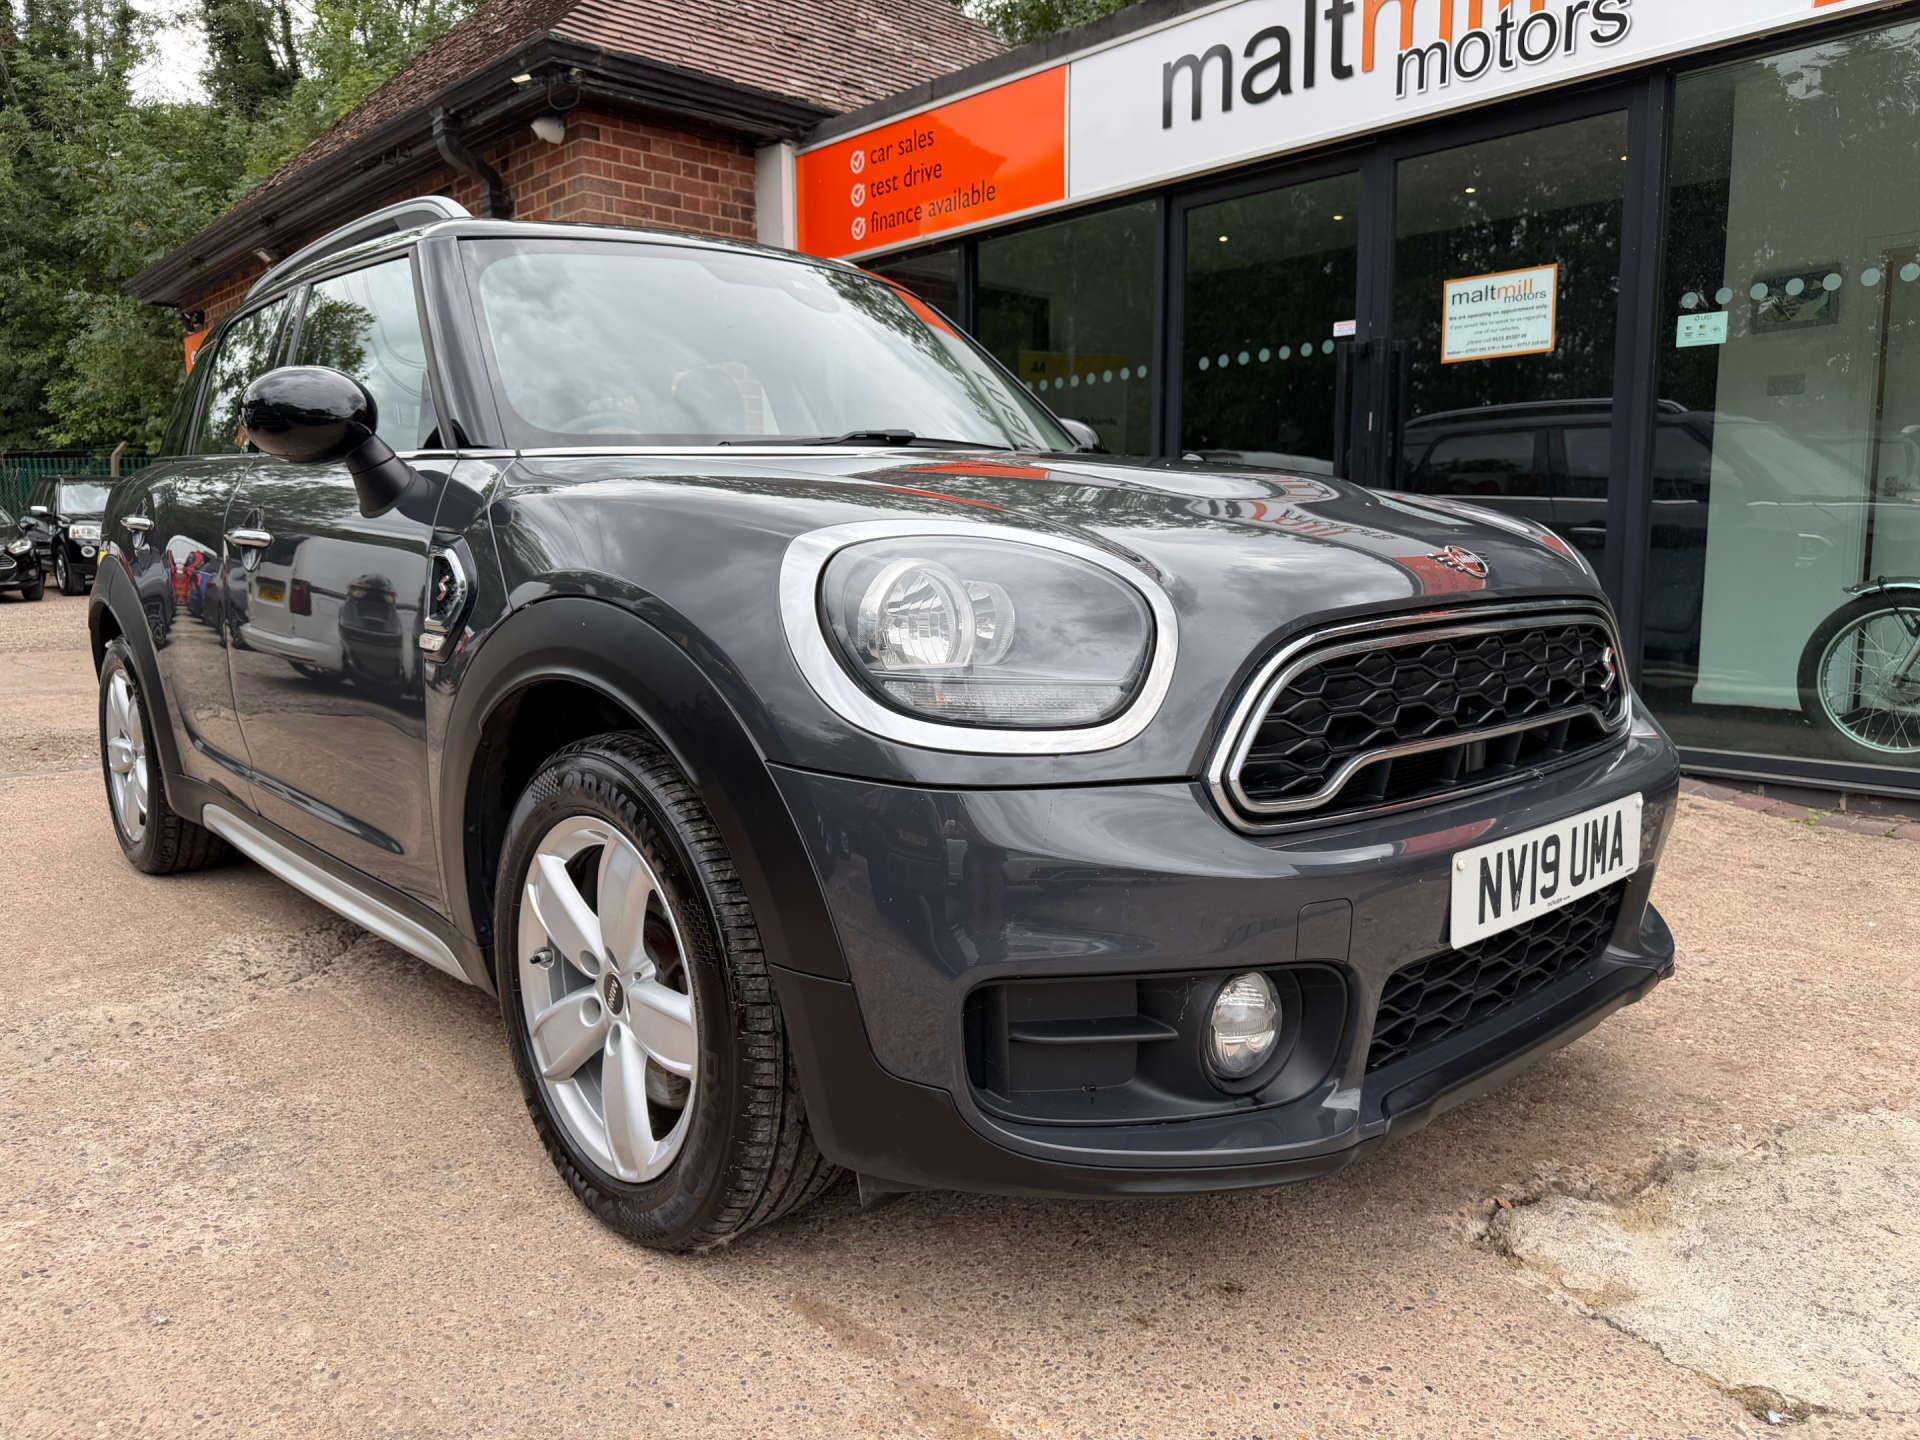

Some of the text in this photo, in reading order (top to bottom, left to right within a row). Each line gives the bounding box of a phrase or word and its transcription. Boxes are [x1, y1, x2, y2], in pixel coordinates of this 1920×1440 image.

[1396, 0, 1630, 97] motors
[870, 129, 934, 164] car sales
[870, 163, 942, 198] test drive
[871, 181, 996, 232] finance available
[1451, 279, 1533, 305] maltmill
[1503, 290, 1546, 304] motors
[1478, 810, 1624, 925] NV19 UMA
[607, 979, 619, 1009] MINI
